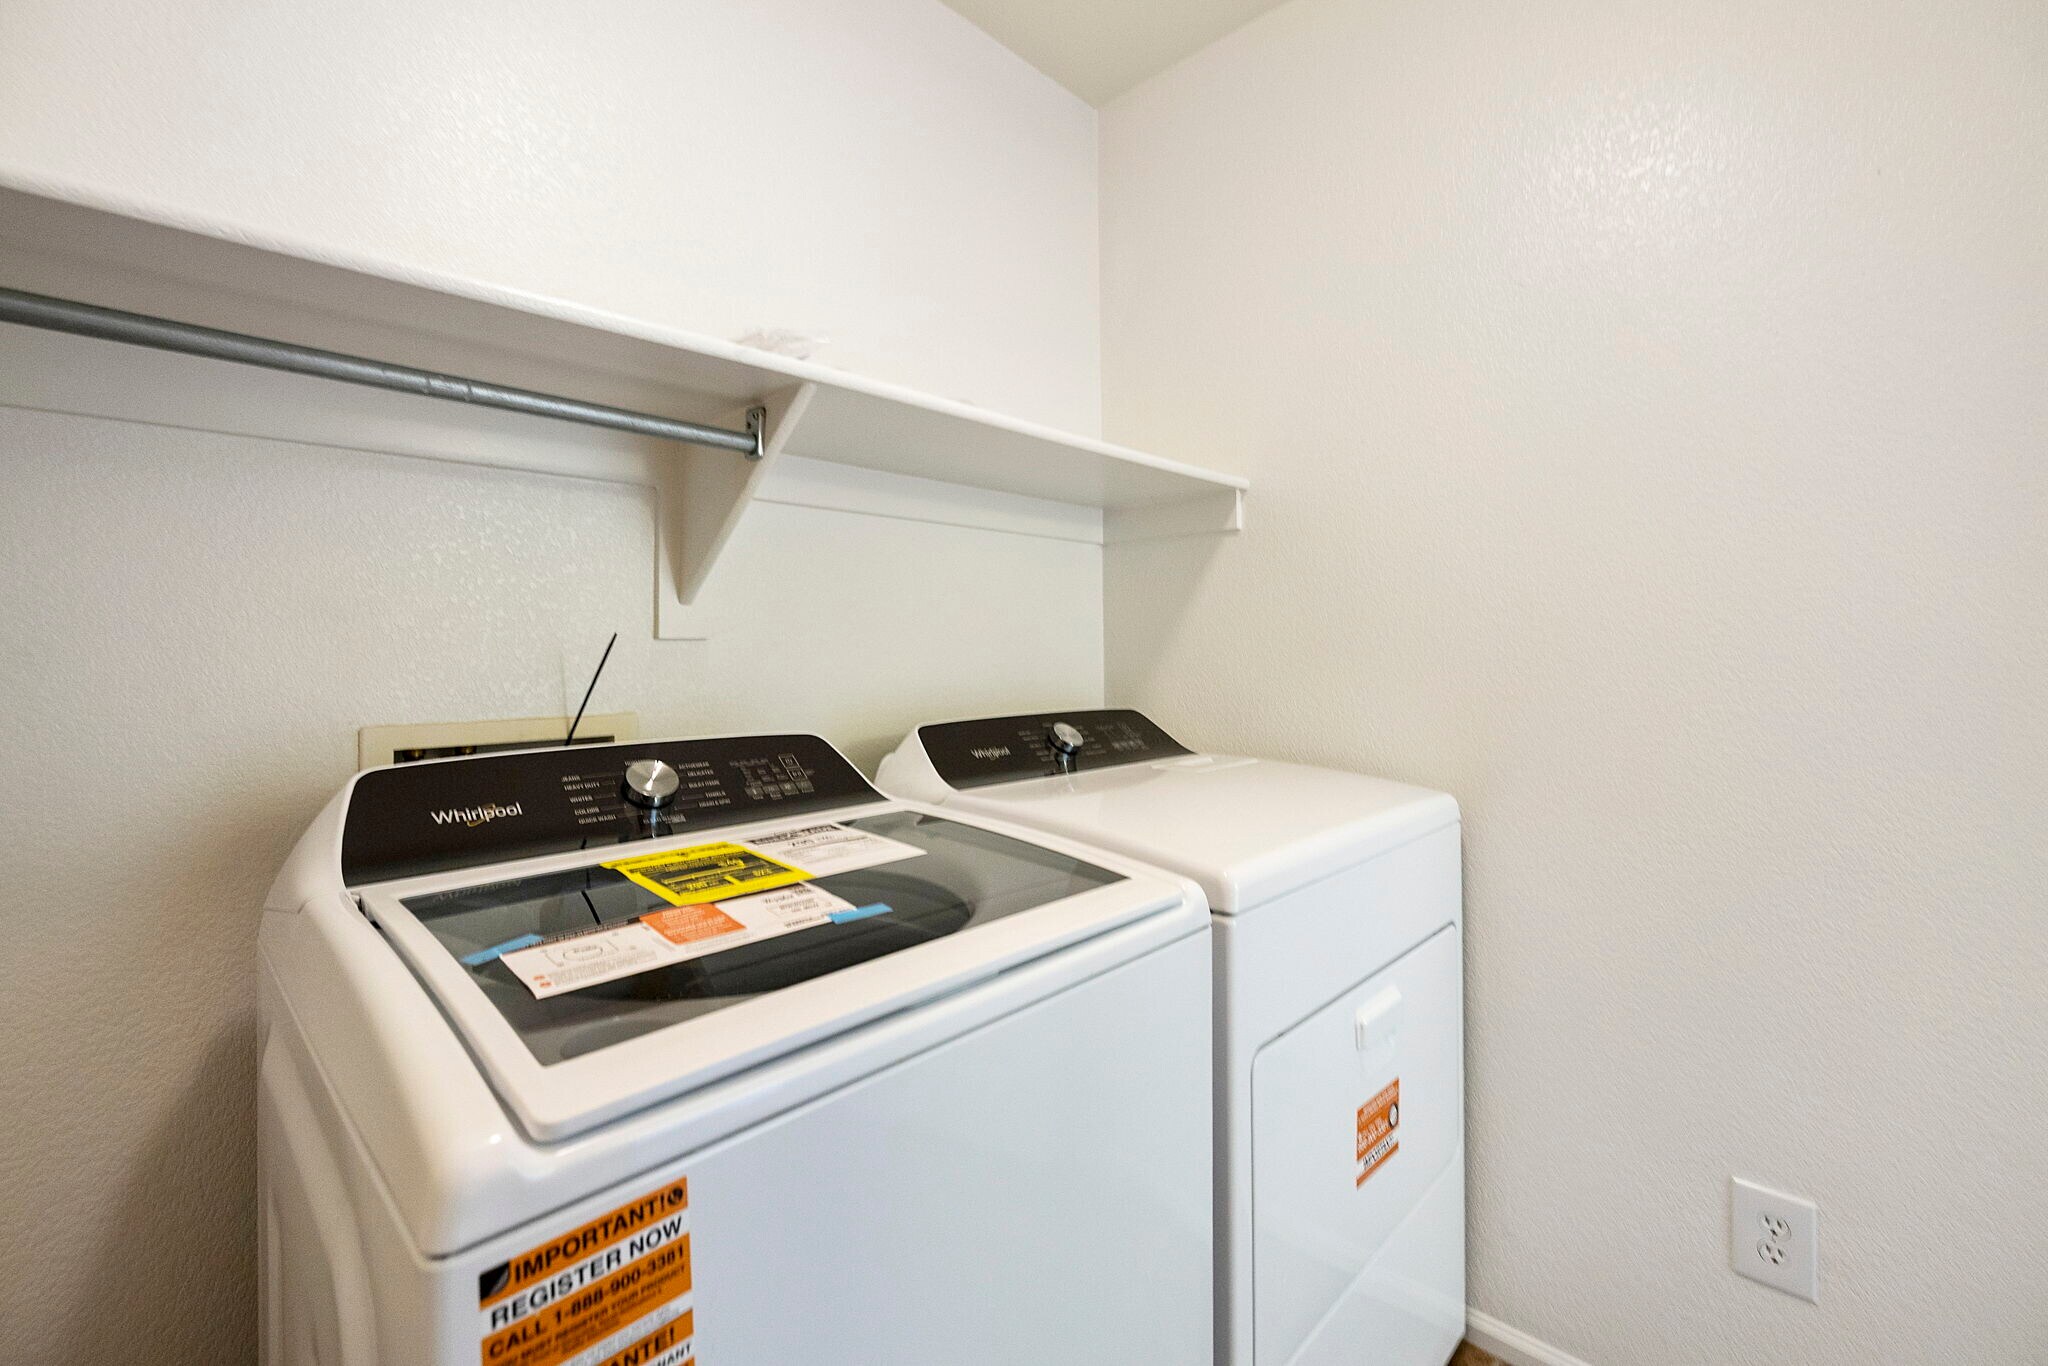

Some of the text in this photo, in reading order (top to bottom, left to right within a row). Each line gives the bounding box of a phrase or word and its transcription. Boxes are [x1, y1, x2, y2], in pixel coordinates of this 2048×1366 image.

[970, 746, 1011, 760] Whirlpool
[430, 802, 523, 826] Whirlpool
[514, 1192, 665, 1284] IMPORTANT!
[491, 1247, 621, 1329] REGISTER
[629, 1215, 682, 1258] NOW
[489, 1320, 547, 1359] CALL
